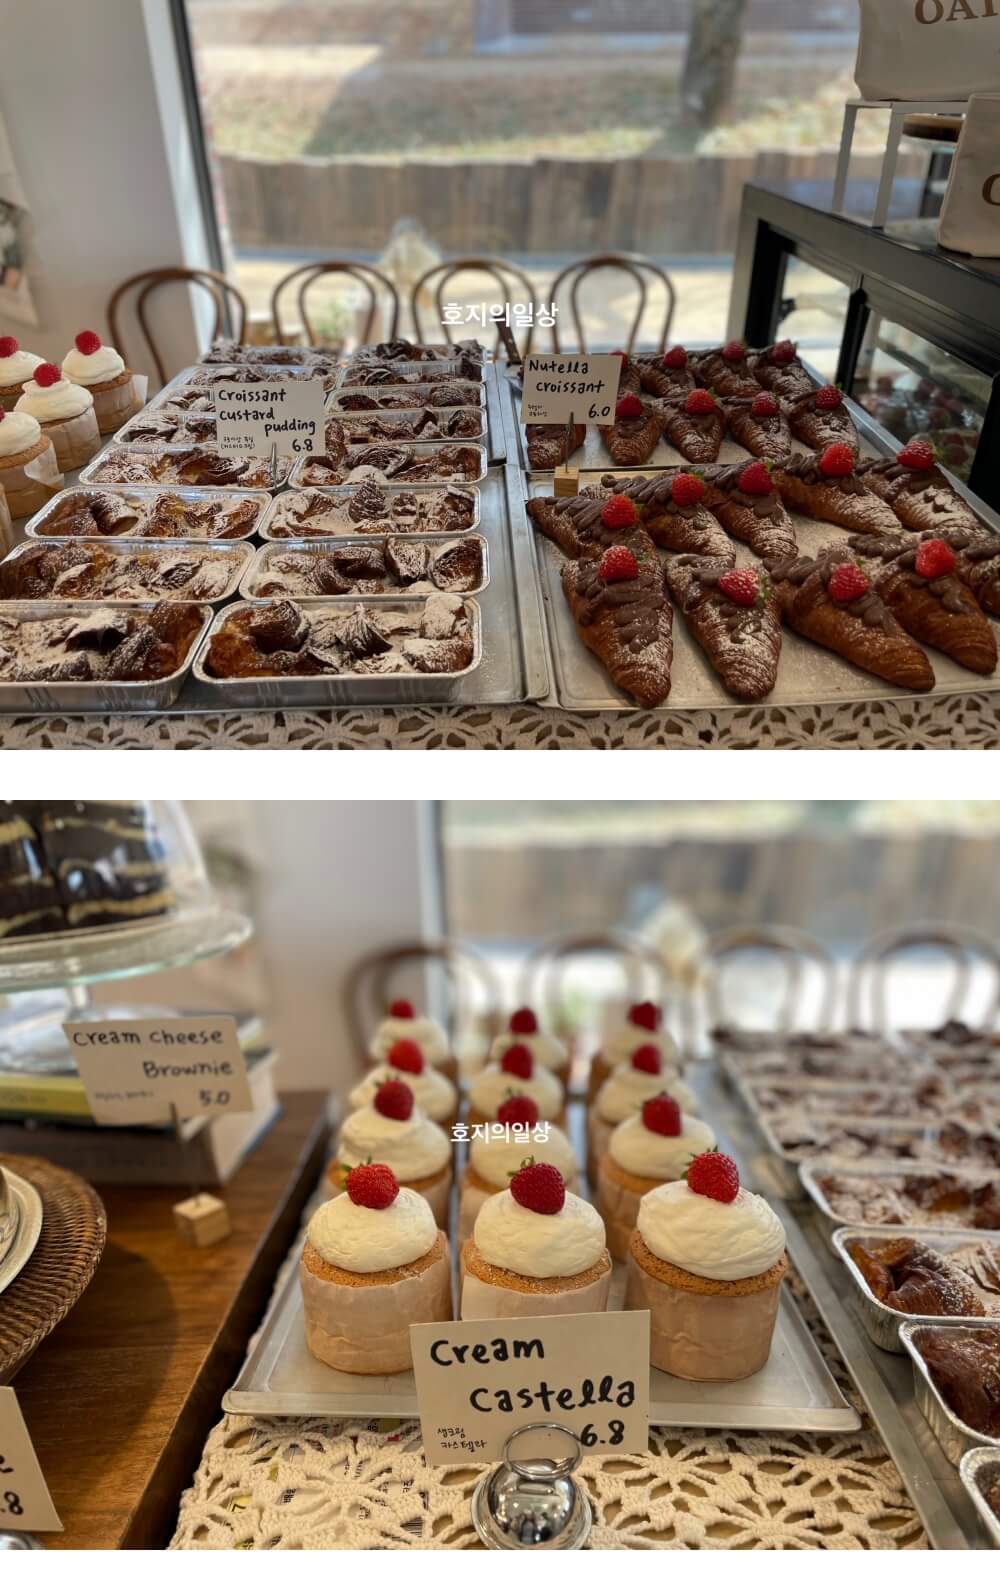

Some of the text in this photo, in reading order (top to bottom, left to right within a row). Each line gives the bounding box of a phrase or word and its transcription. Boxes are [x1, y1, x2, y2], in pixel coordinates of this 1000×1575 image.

[529, 360, 588, 374] Nutella
[218, 388, 287, 402] Croissant
[588, 403, 611, 418] 6.0
[264, 418, 316, 437] pudding
[292, 438, 313, 452] 6.8
[142, 1060, 233, 1079] Brownie
[198, 1088, 231, 1106] 5.0
[580, 1419, 626, 1447] 6.8
